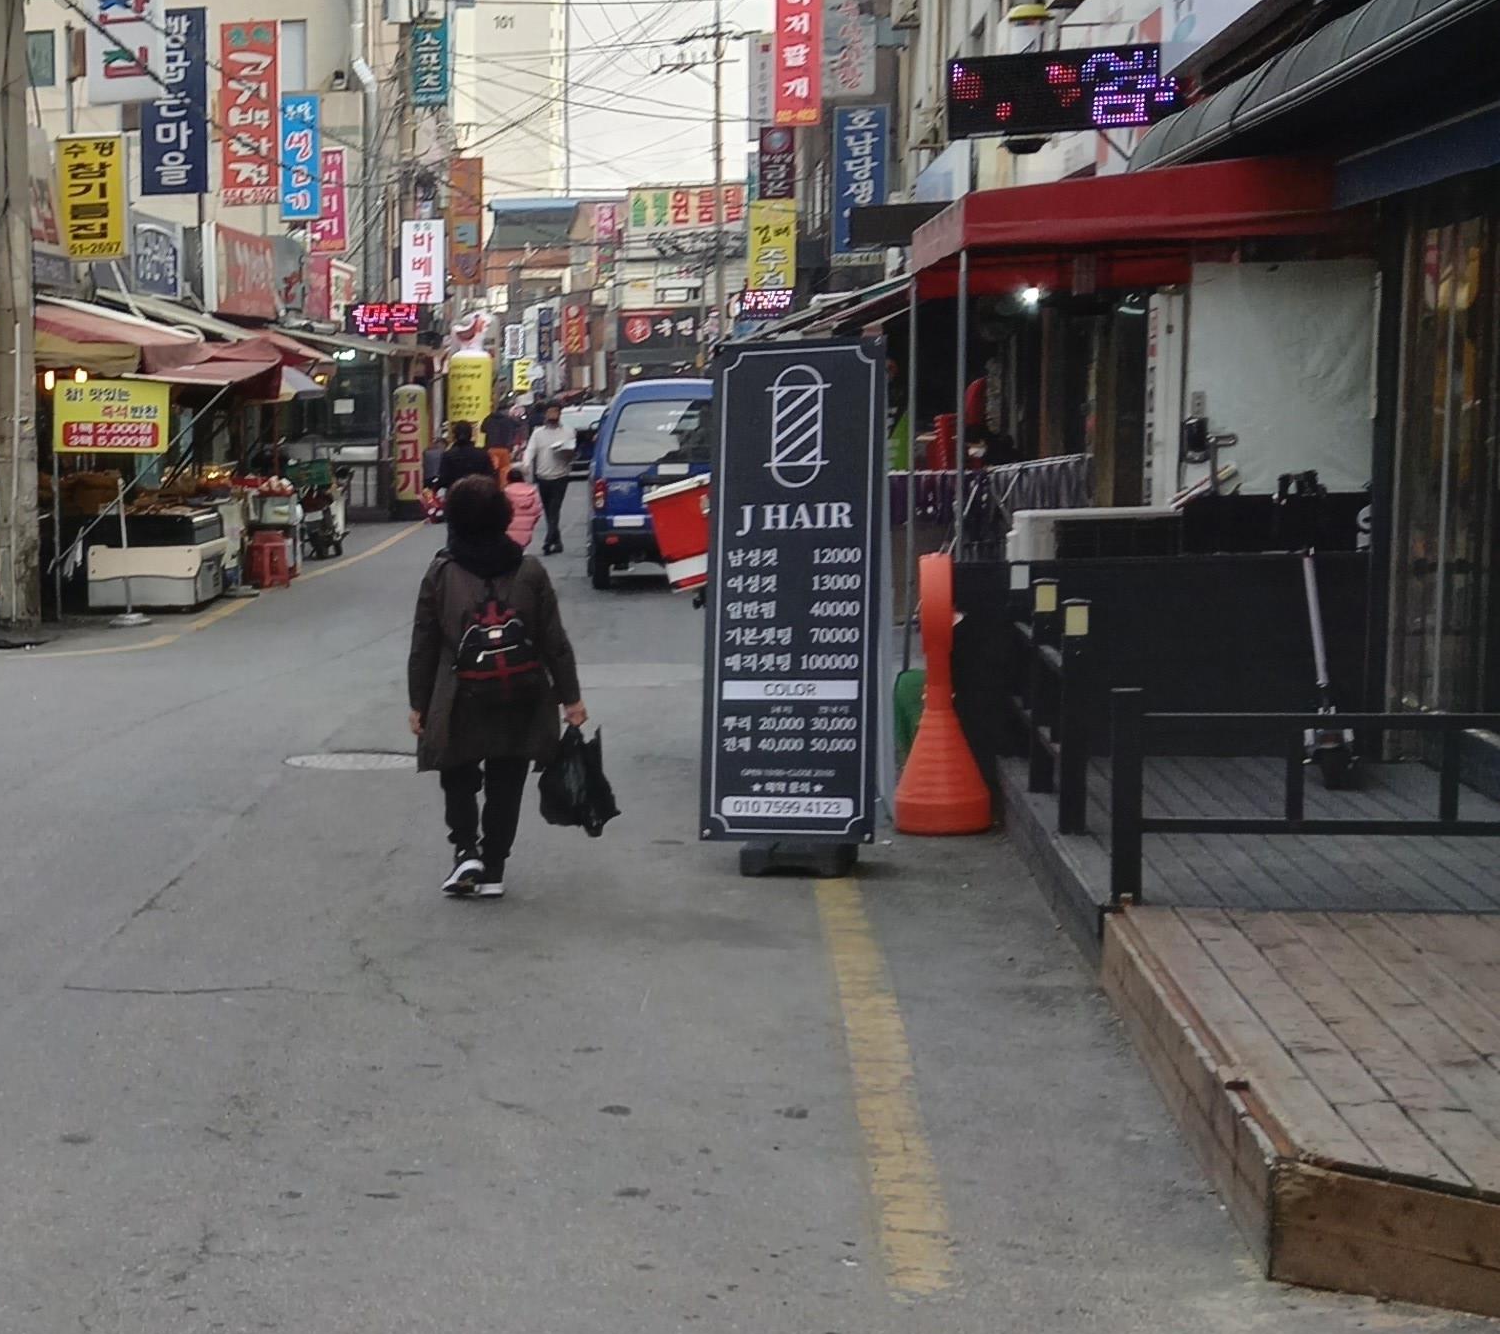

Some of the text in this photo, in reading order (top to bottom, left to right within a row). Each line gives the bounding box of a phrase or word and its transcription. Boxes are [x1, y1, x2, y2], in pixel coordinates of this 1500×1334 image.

[412, 231, 435, 303] 바베큐
[396, 409, 420, 495] 생고기
[735, 501, 854, 537] J HAIR
[727, 547, 863, 568] 남성컷 12000
[811, 574, 862, 591] 13000
[809, 600, 861, 617] 40000
[808, 627, 860, 644] 70000
[799, 653, 859, 672] 100000
[763, 683, 817, 697] COLOR
[758, 716, 806, 732] 20,000
[809, 716, 858, 732] 30,000
[757, 737, 805, 753] 40,000
[733, 800, 761, 814] 010
